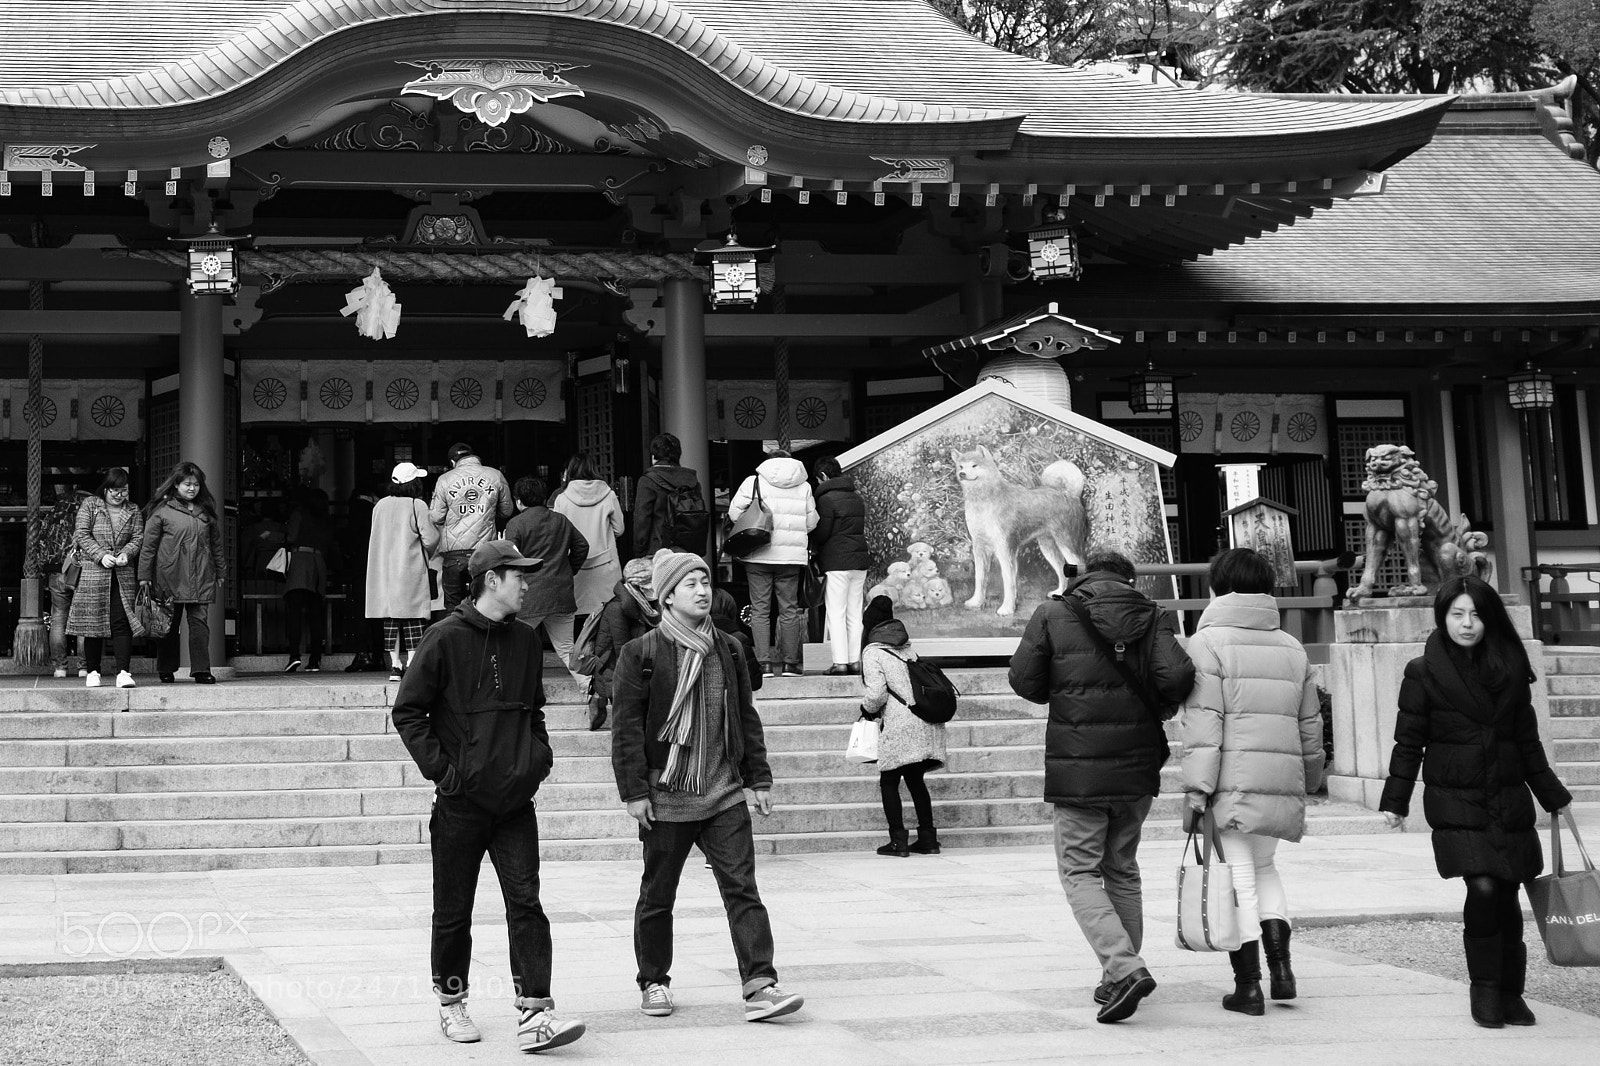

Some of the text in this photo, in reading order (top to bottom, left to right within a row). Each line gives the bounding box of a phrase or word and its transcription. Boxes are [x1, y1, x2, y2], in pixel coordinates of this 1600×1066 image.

[448, 476, 495, 498] AVIREX
[459, 504, 485, 515] USN
[1105, 490, 1116, 537] 生田神社
